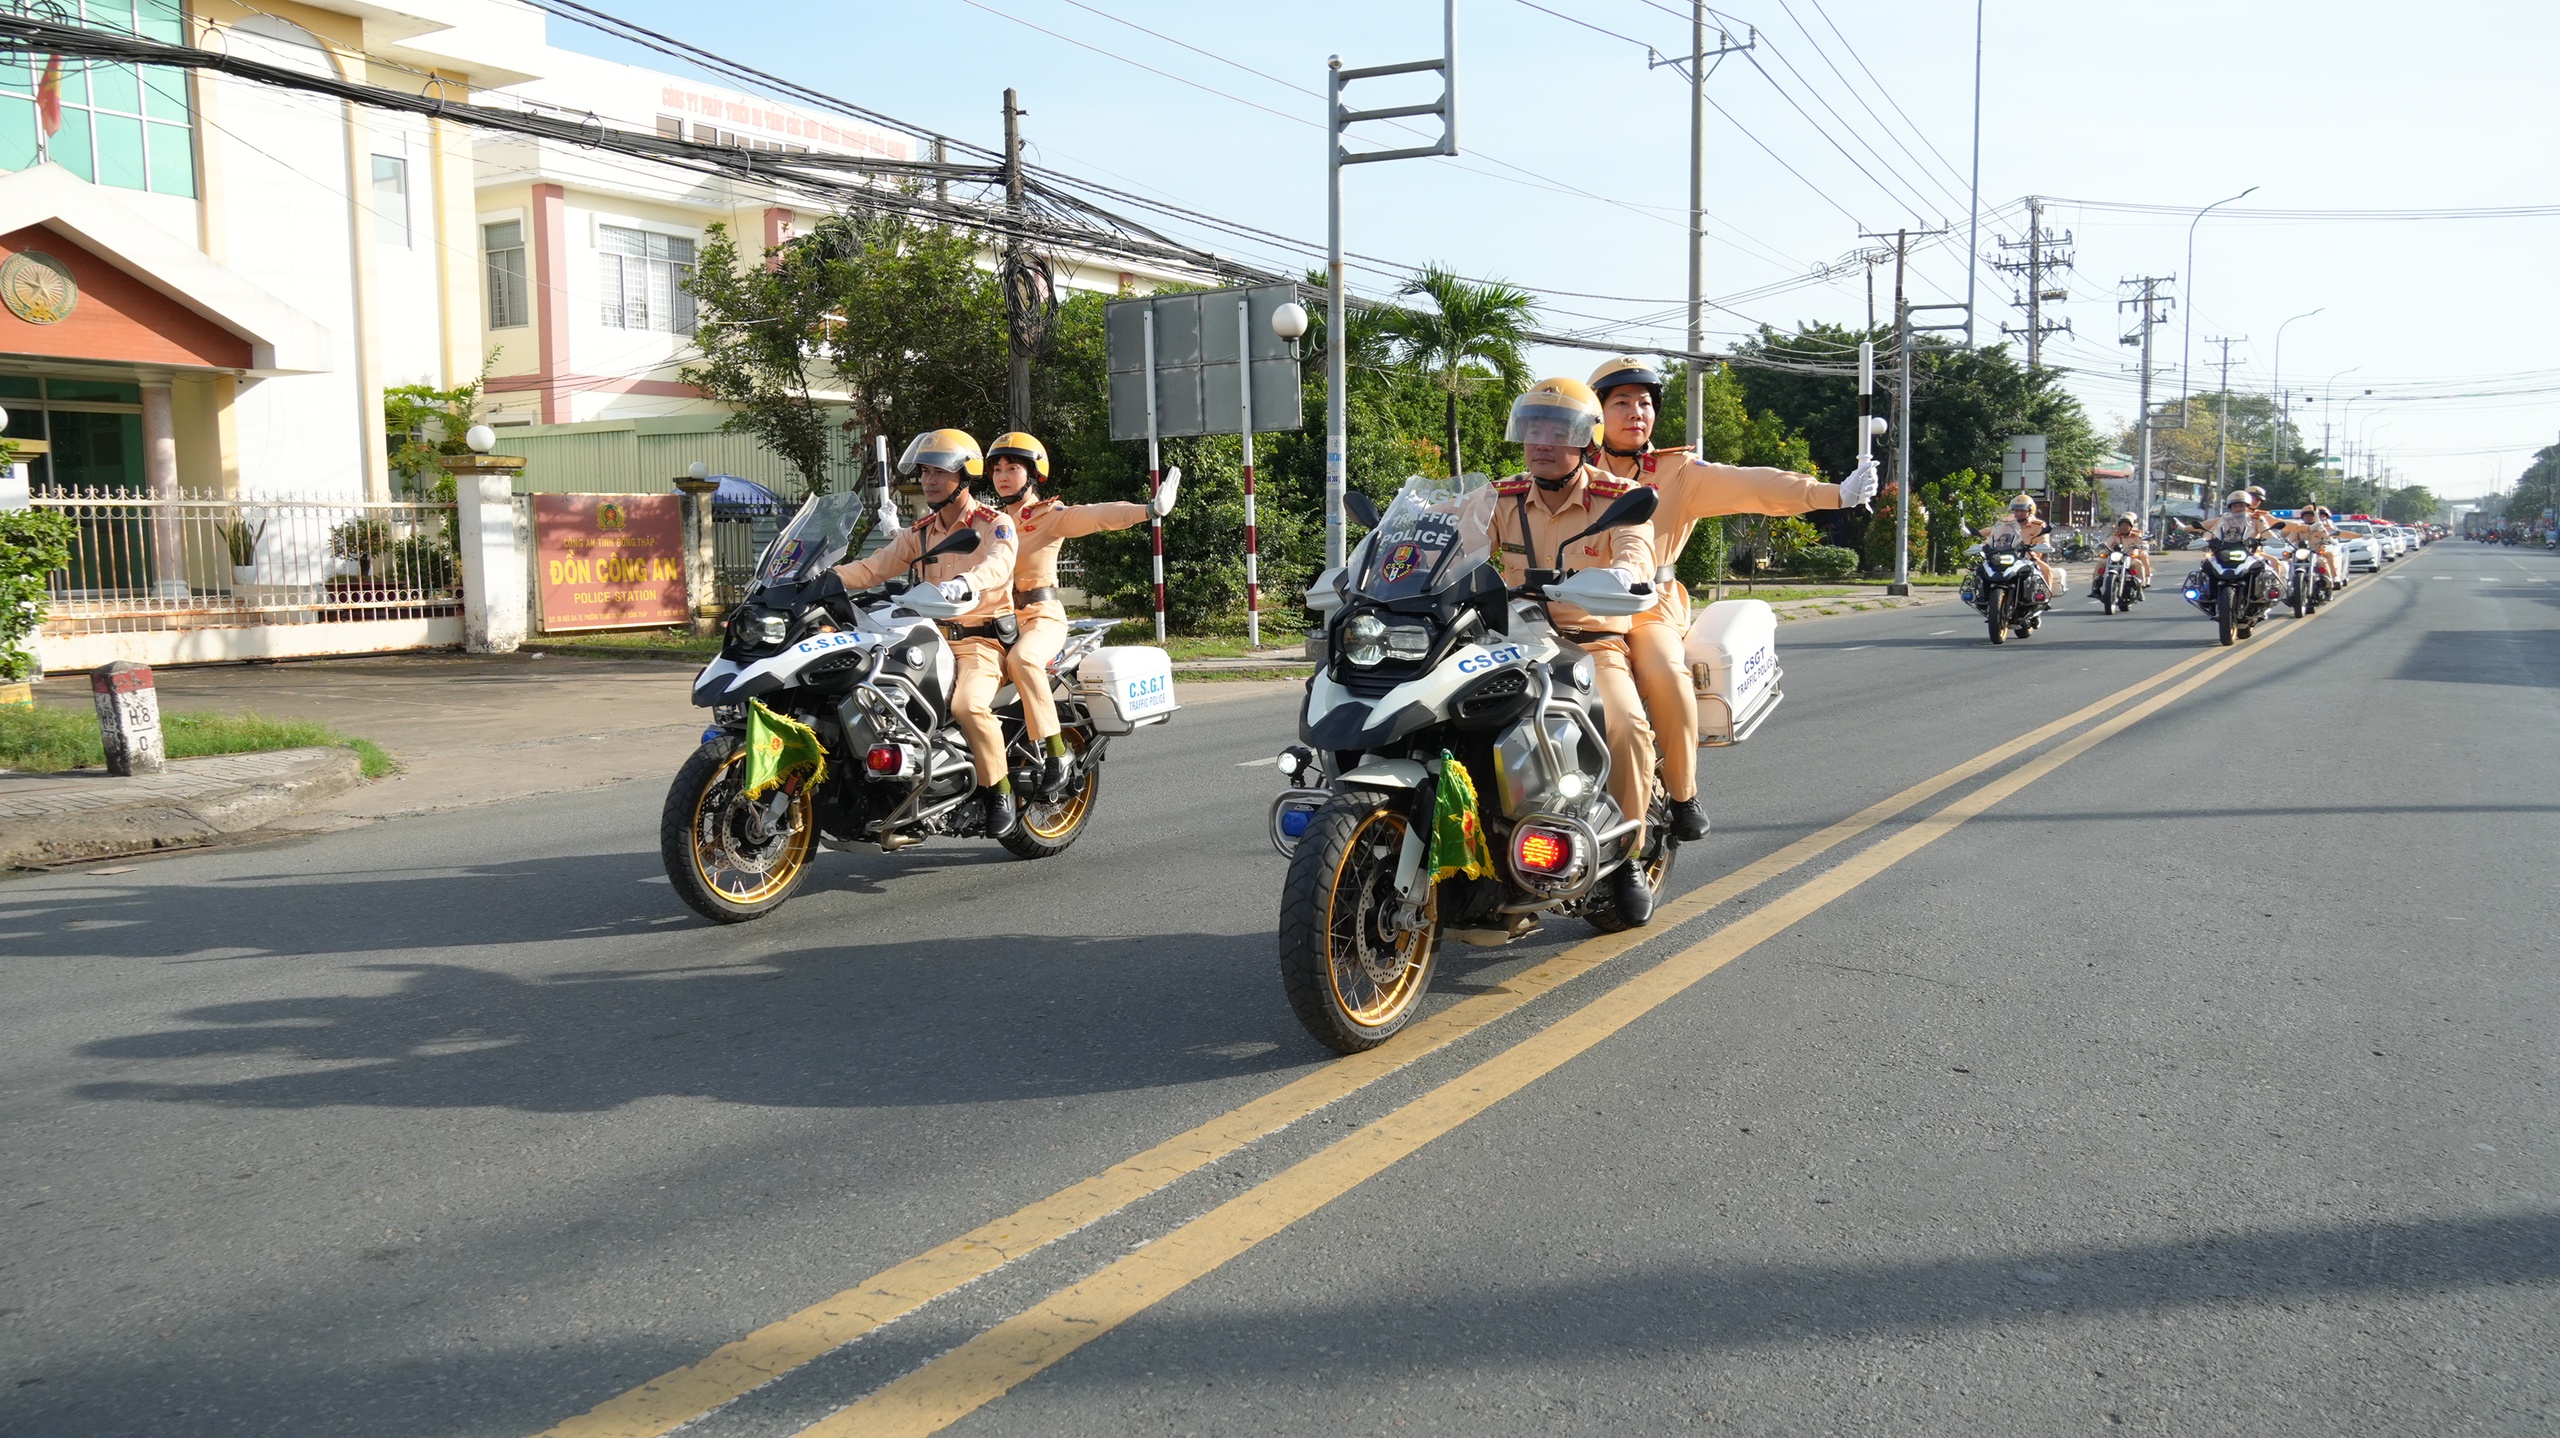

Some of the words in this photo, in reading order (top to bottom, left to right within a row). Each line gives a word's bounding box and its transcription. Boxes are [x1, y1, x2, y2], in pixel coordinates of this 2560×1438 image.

[586, 538, 596, 547] AN
[1379, 529, 1452, 547] POLICE
[549, 549, 592, 585] ĐỒN
[595, 552, 648, 583] CÔNG
[652, 557, 678, 582] AN
[574, 592, 611, 604] POLICE
[614, 590, 657, 602] STATION
[798, 632, 861, 653] C.S.G.T
[1458, 646, 1522, 673] CSGT
[1744, 646, 1765, 675] CSGT
[1129, 675, 1165, 698] C.S.G.T
[1737, 671, 1758, 697] TRAFFIC
[1758, 655, 1773, 679] POLICE
[1129, 697, 1149, 711] TRAFFIC
[1149, 693, 1166, 707] POLICE
